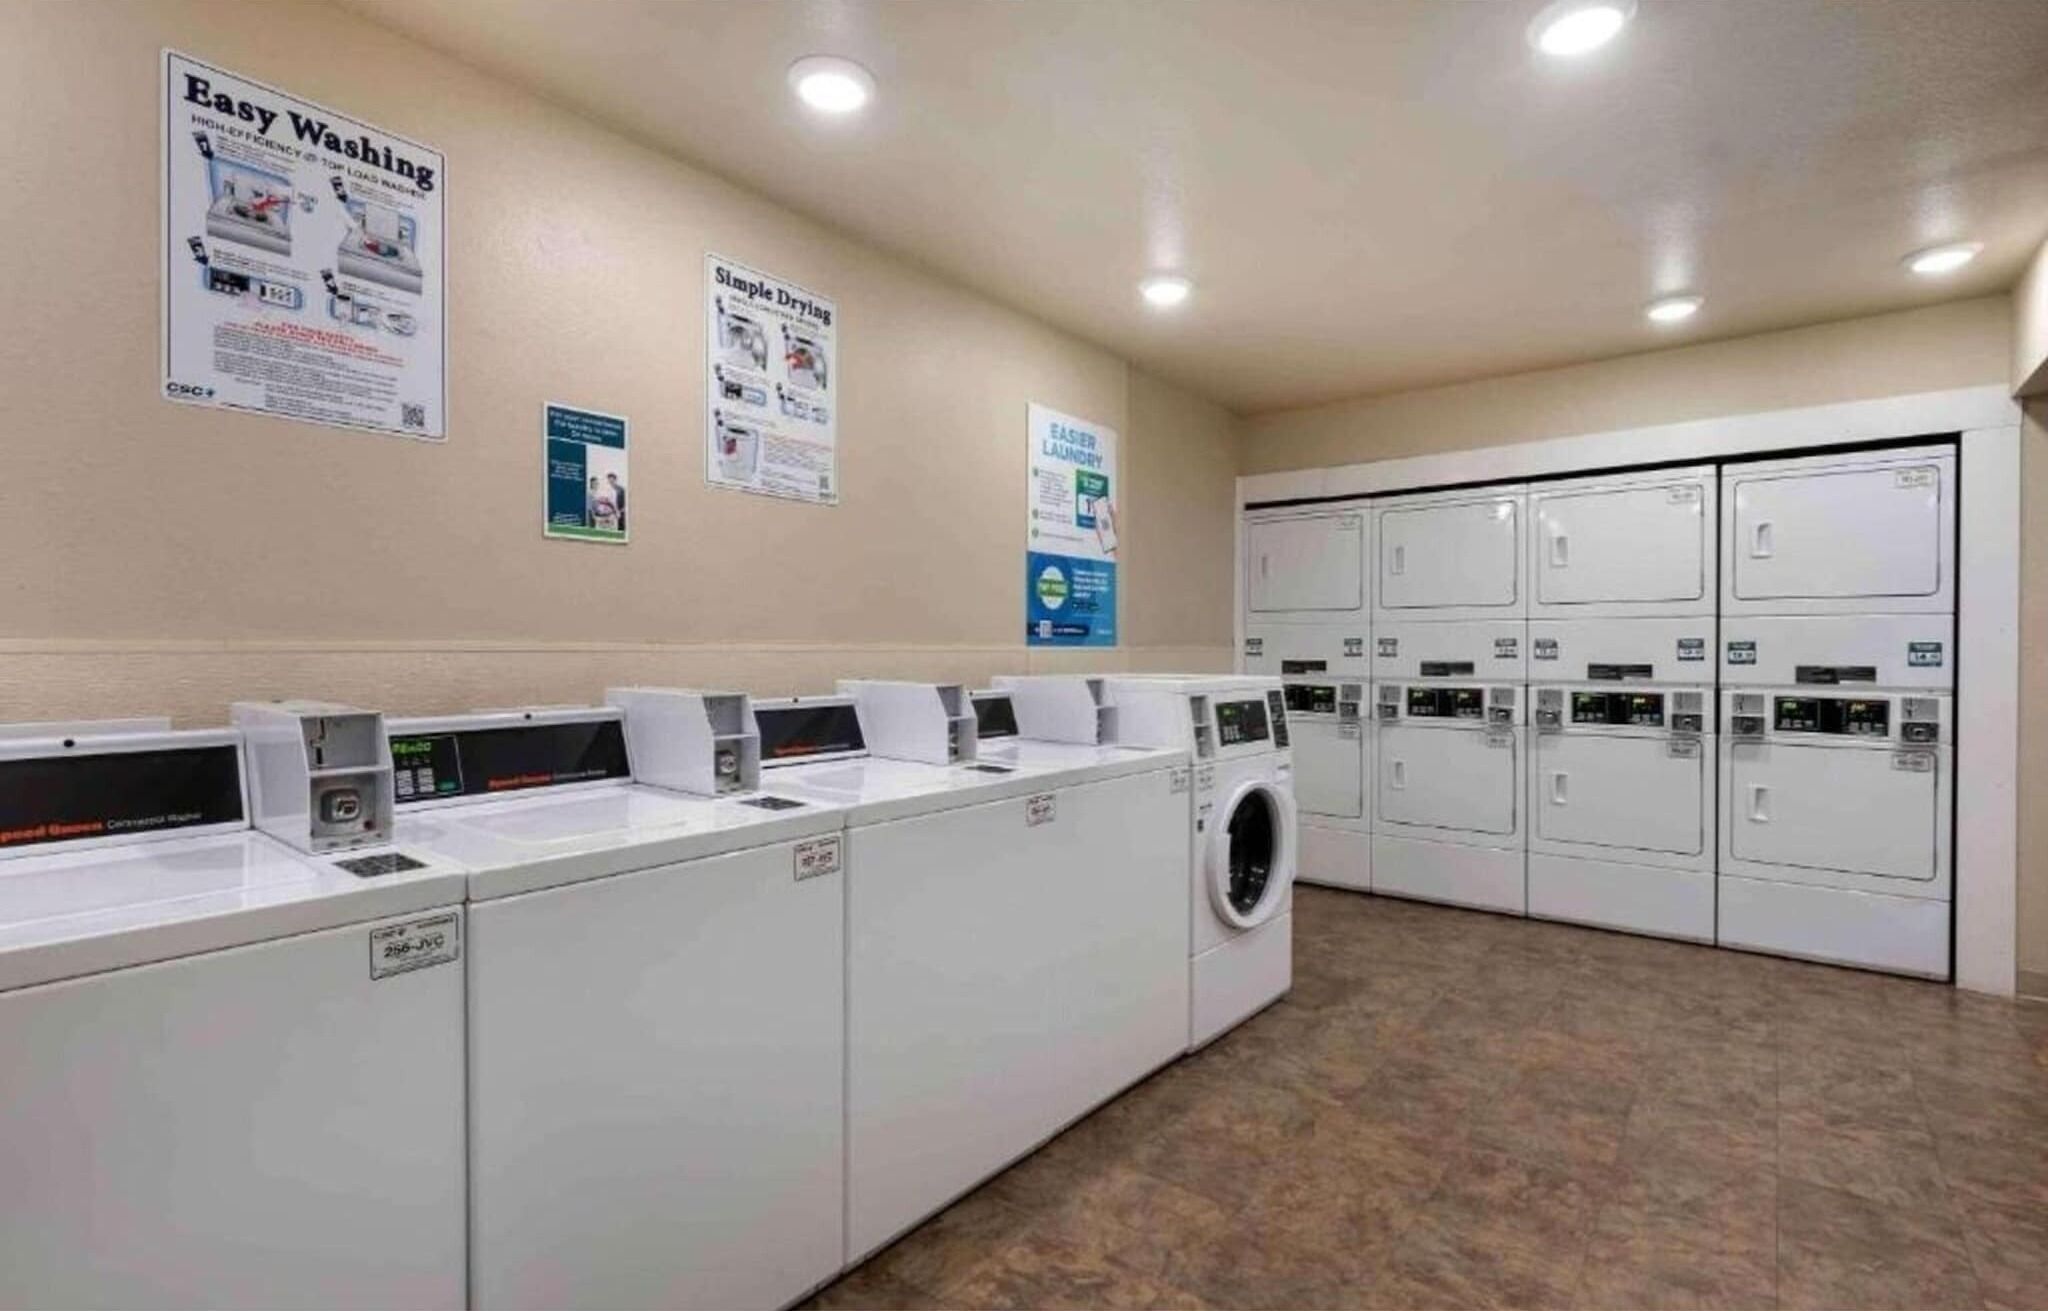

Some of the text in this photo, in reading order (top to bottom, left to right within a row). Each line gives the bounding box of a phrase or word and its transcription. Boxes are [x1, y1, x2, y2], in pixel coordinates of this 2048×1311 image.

[183, 73, 278, 135] Easy
[287, 110, 435, 192] Washing
[191, 113, 303, 159] HIGH-EFFICIENCY
[321, 158, 345, 172] TOP
[347, 166, 379, 184] LOAD
[715, 266, 773, 300] Simple
[776, 287, 831, 326] Drying
[1043, 440, 1103, 468] LAUNDRY
[1050, 422, 1096, 450] EASIER
[0, 824, 46, 843] peed
